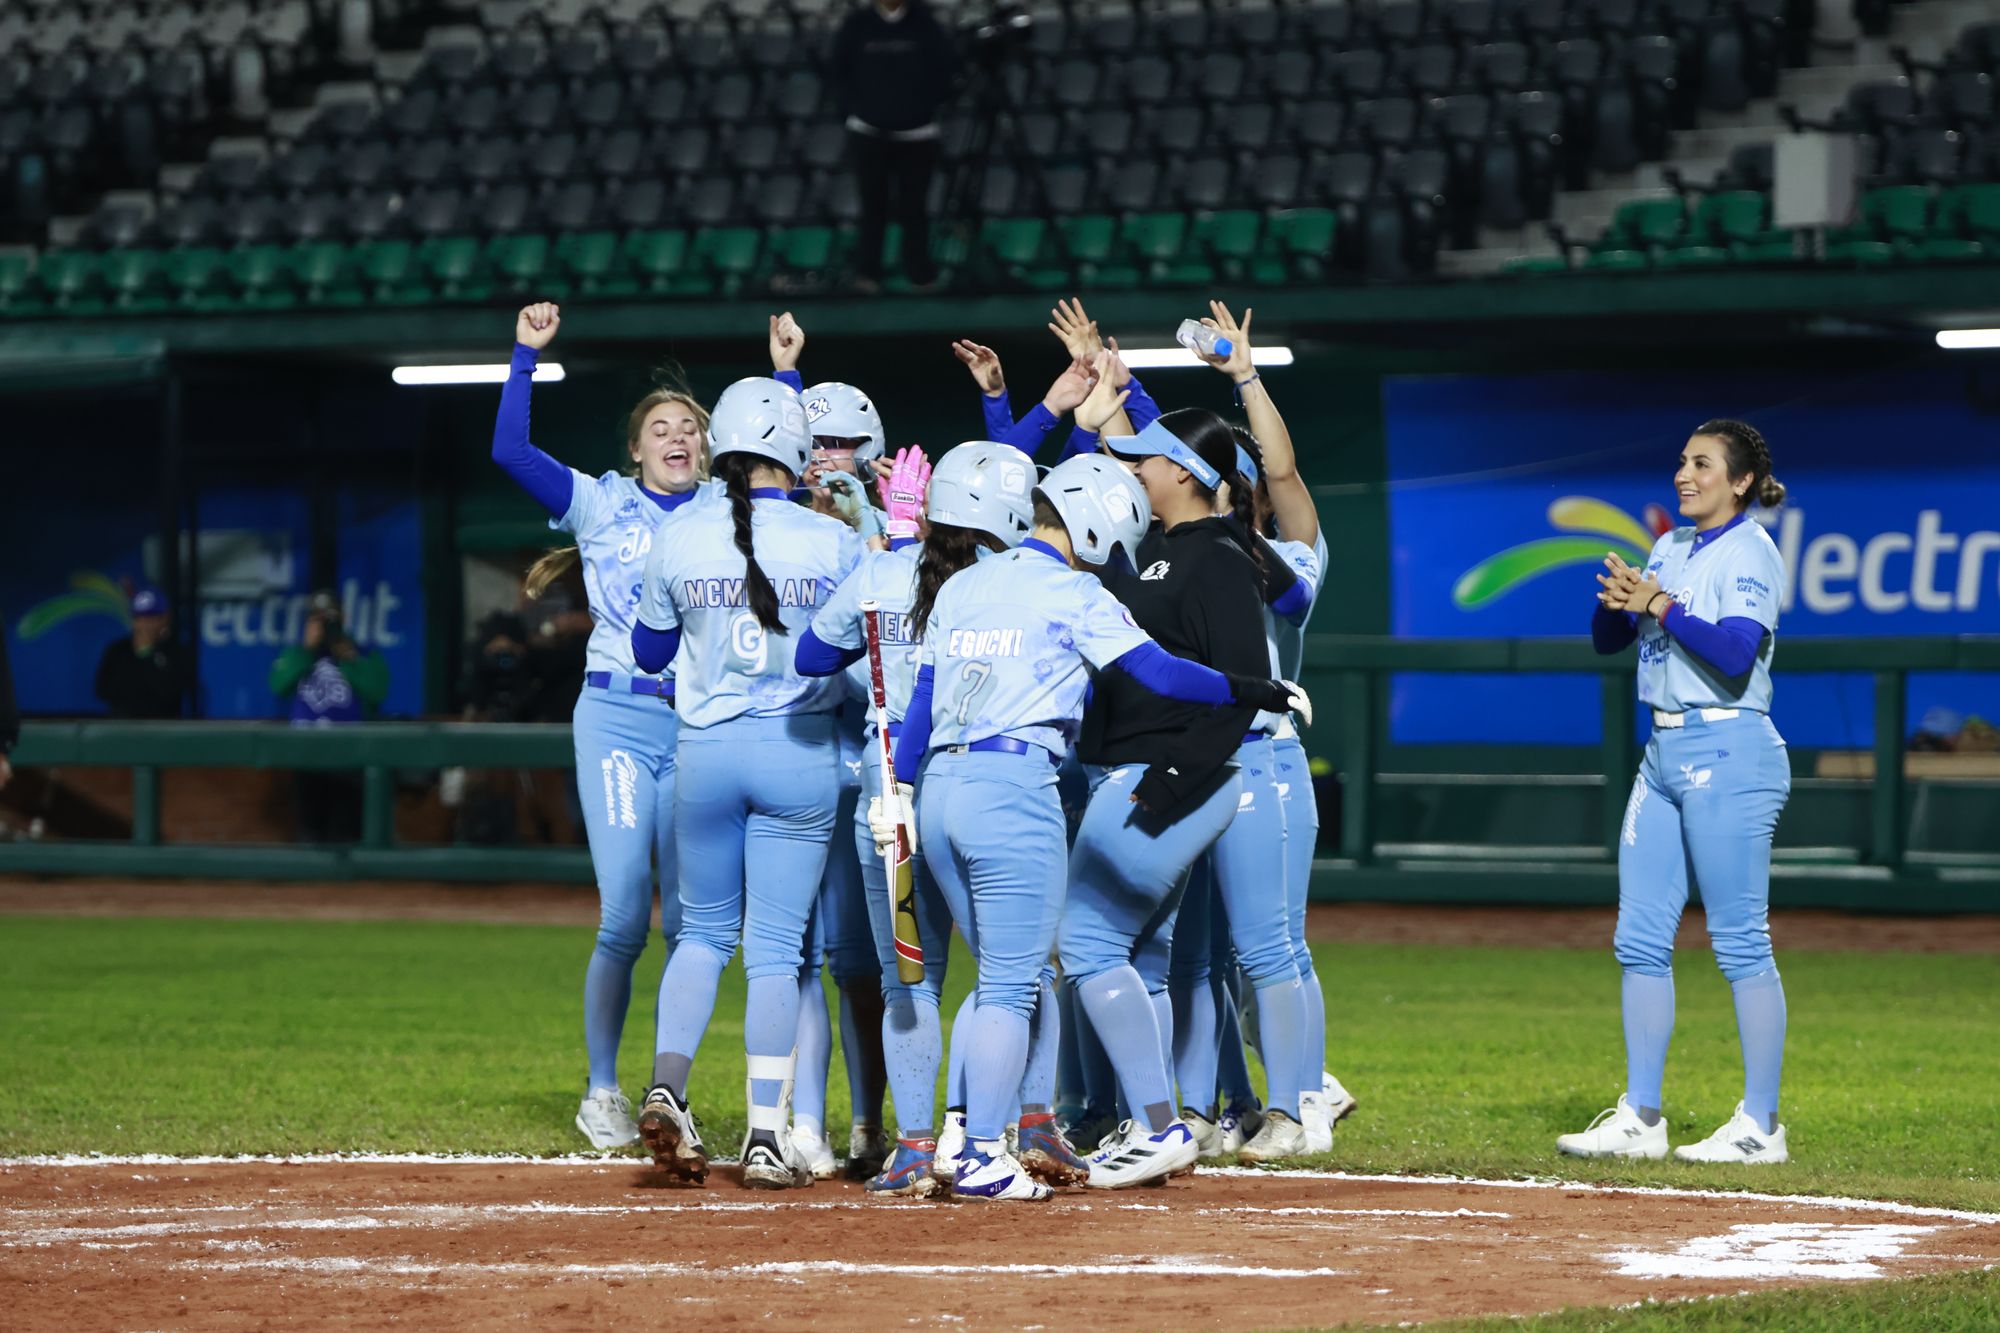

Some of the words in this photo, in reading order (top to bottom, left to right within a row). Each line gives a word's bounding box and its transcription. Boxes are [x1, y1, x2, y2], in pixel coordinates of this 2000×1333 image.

[1744, 507, 2000, 614] lectr
[730, 611, 769, 677] 9
[947, 628, 1024, 658] EGUCHI
[957, 660, 993, 726] 7
